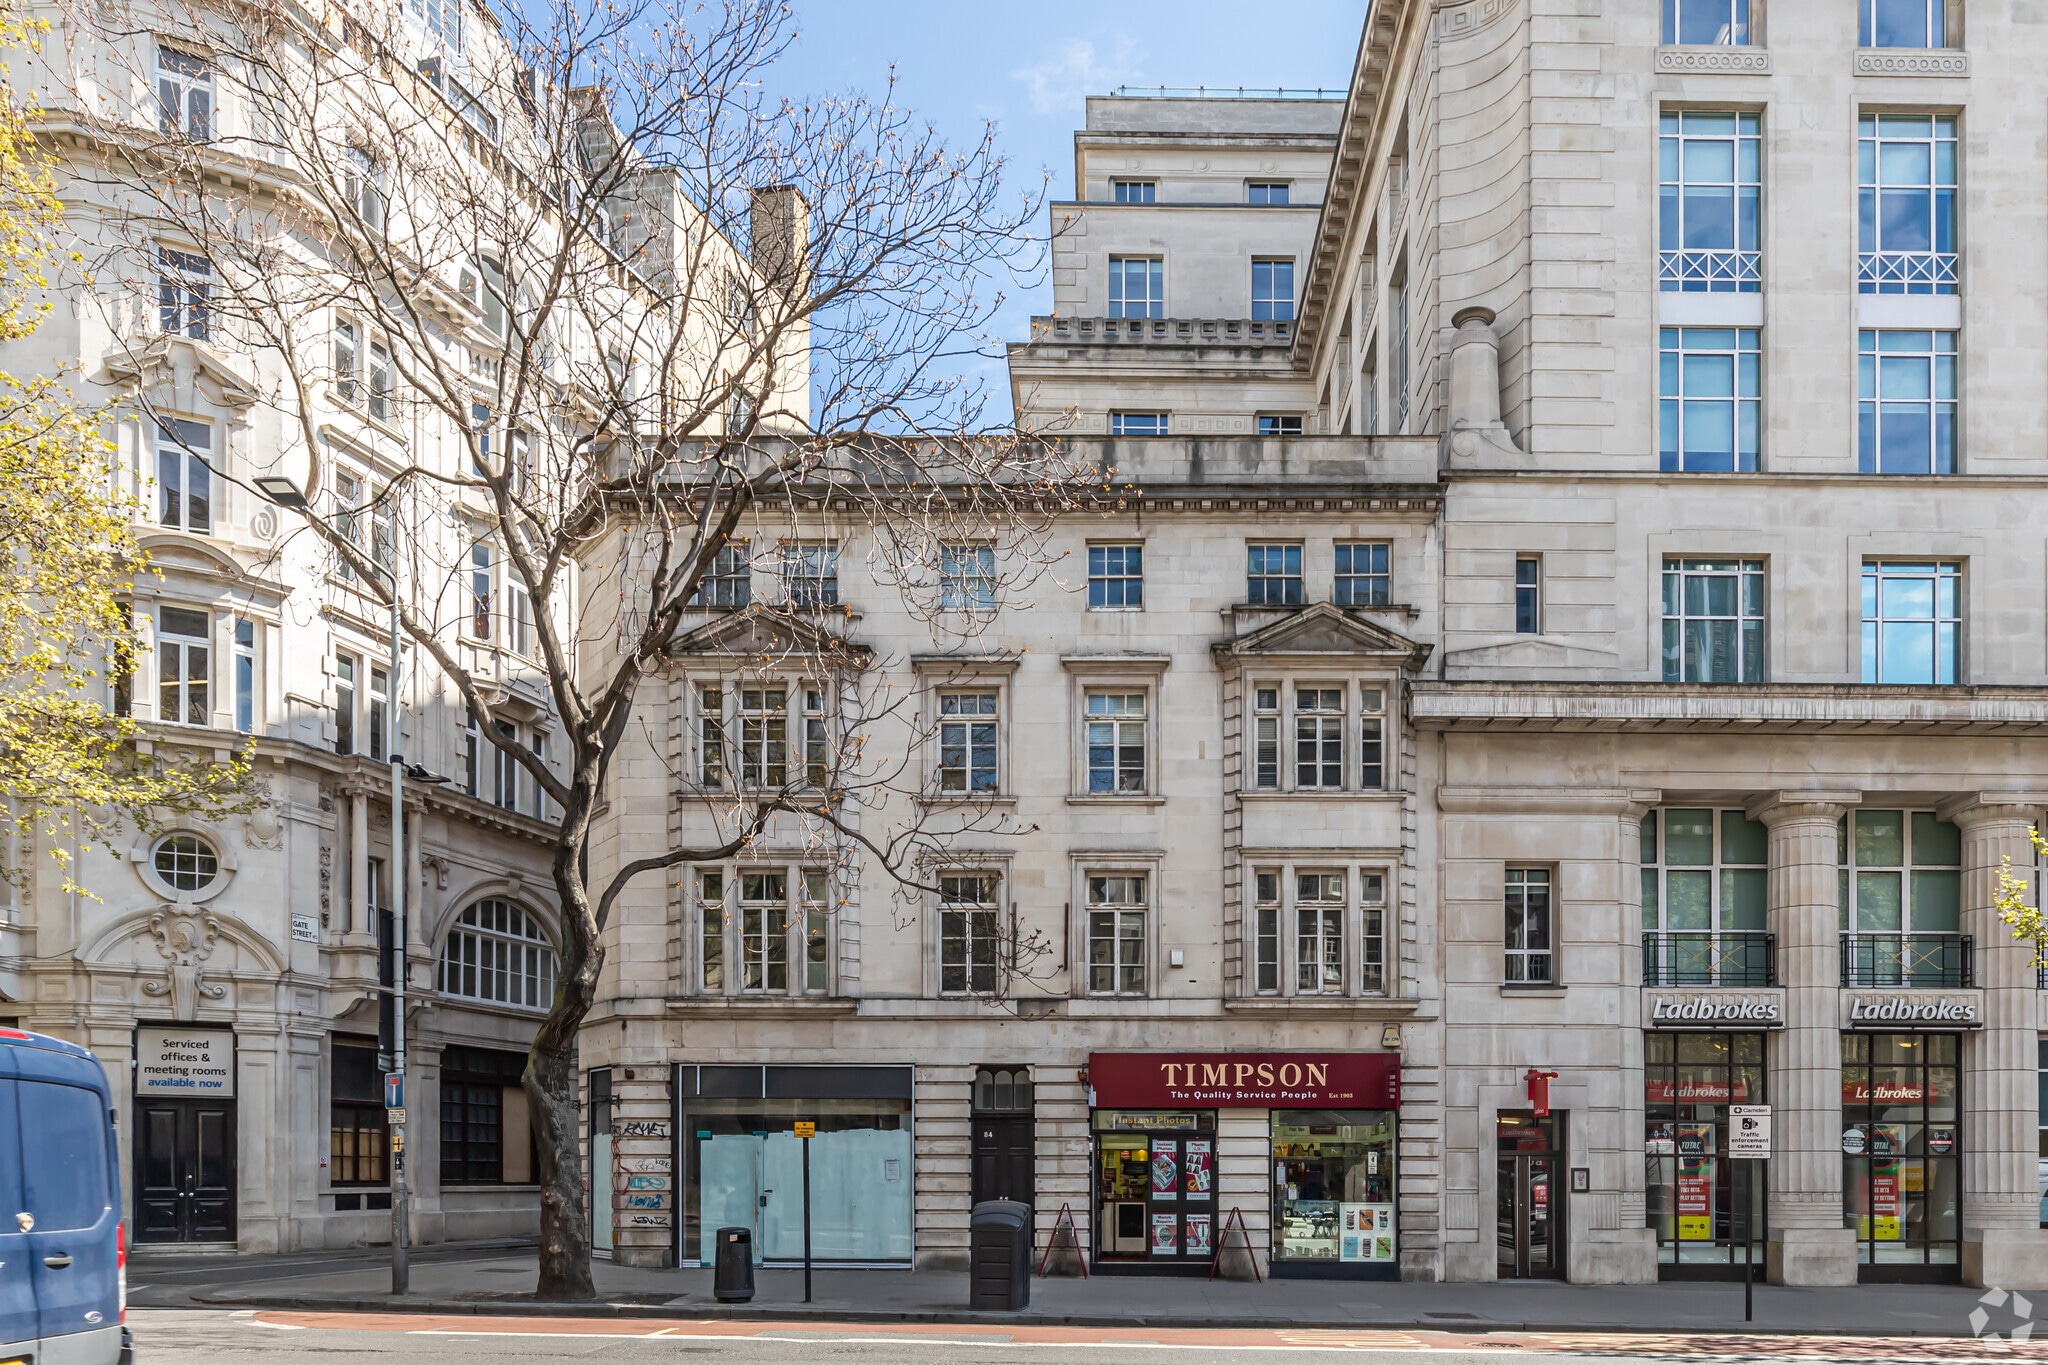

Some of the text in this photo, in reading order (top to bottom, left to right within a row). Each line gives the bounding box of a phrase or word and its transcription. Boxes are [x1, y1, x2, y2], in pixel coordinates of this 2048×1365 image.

[292, 920, 309, 930] GATE
[292, 928, 312, 939] STREET
[1652, 997, 1779, 1020] Ladbrokes
[1850, 998, 1976, 1020] Ladbrokes
[162, 1039, 209, 1049] Serviced
[161, 1052, 210, 1062] offices &
[144, 1065, 226, 1077] meeting rooms
[1160, 1063, 1329, 1087] TIMPSON
[148, 1078, 223, 1088] available now
[1170, 1090, 1318, 1100] The Quality Service People
[1663, 1085, 1729, 1098] Ladbrokes
[1855, 1086, 1922, 1099] Ladbrokes
[1118, 1115, 1191, 1125] Instant Photos
